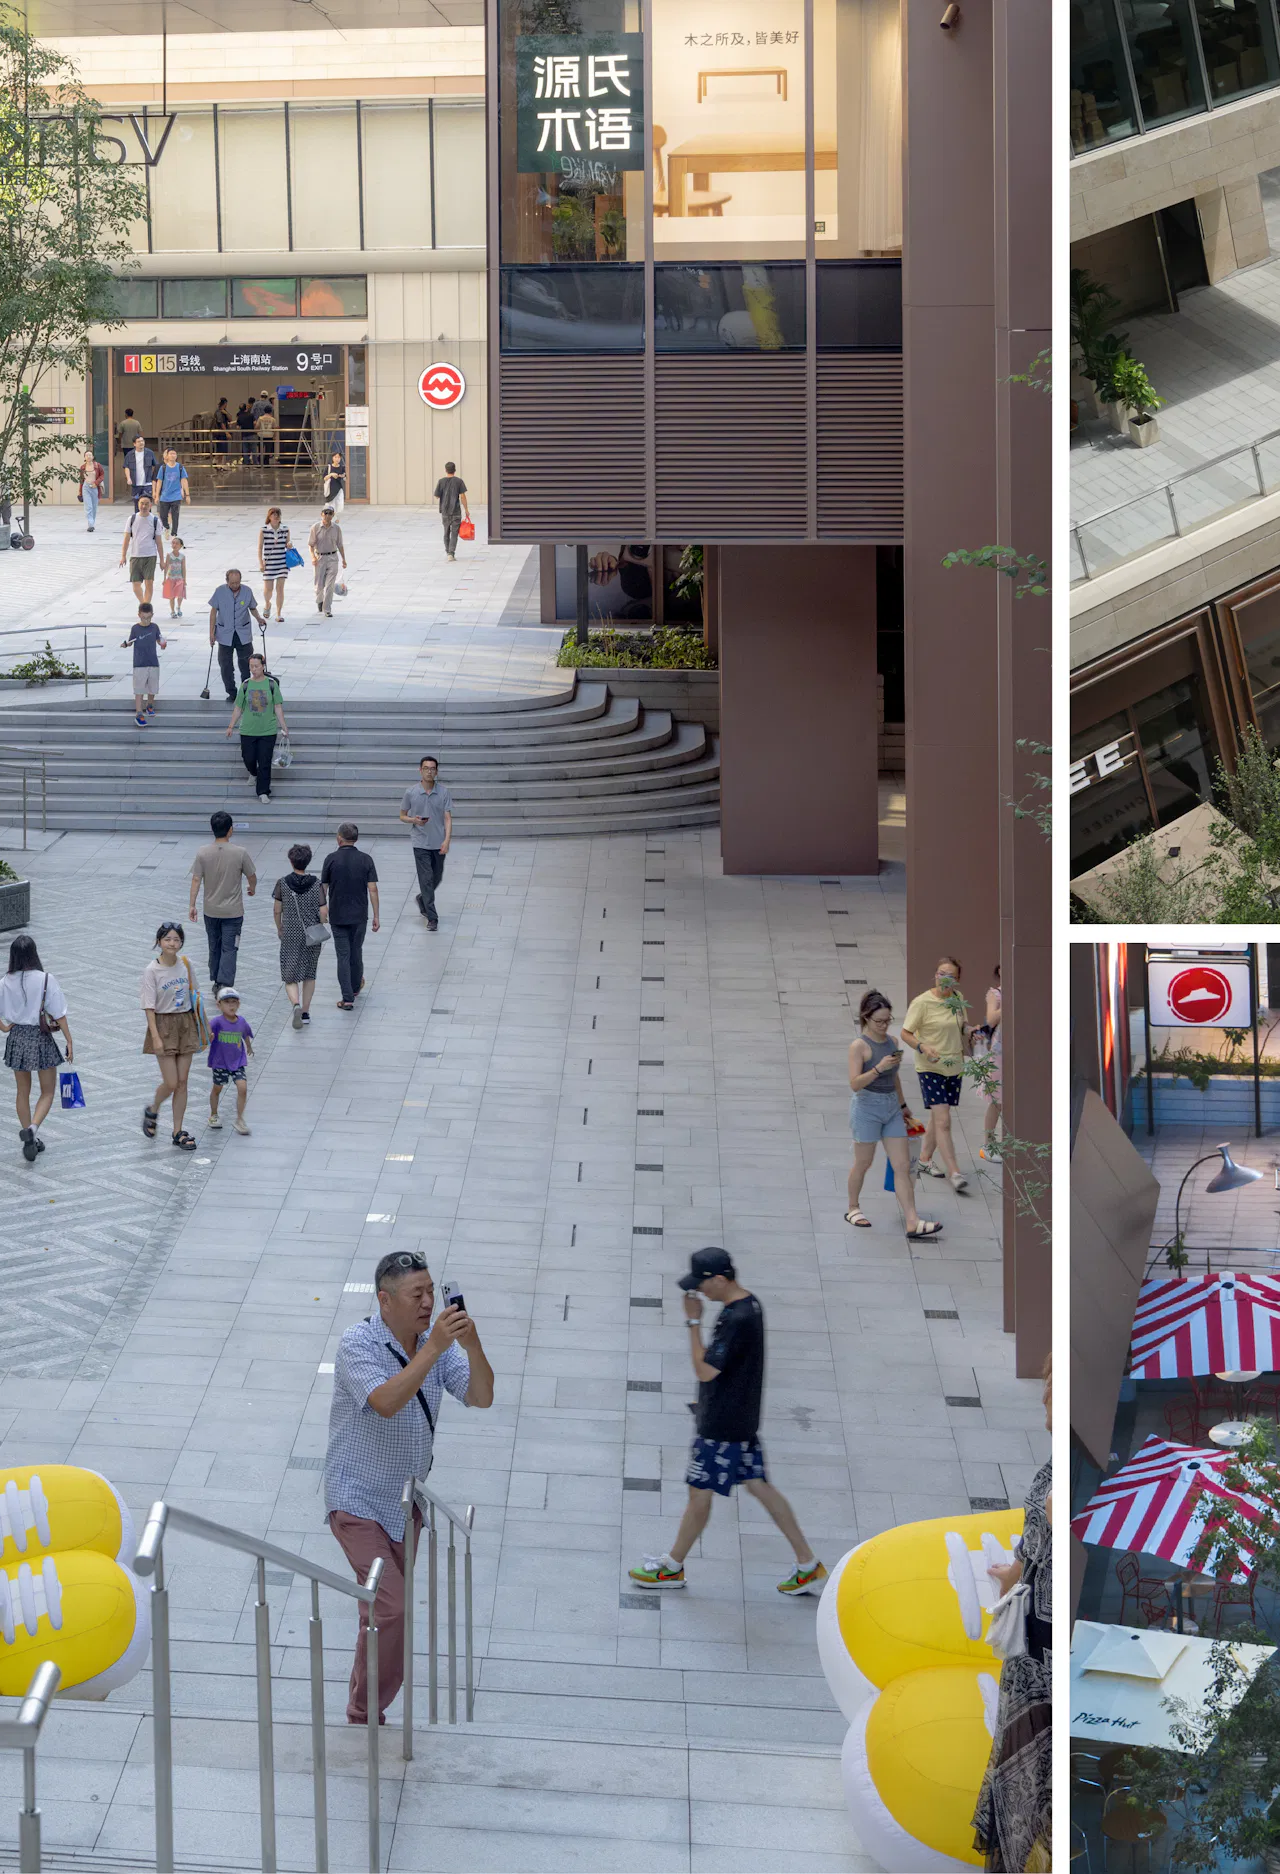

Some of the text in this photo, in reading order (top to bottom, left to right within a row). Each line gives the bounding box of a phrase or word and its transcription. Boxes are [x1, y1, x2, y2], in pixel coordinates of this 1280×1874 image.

[533, 54, 631, 99] 源氏
[536, 107, 632, 152] 木语
[128, 355, 201, 372] 1 3 15 号线
[230, 354, 272, 365] 上海南站
[296, 352, 333, 372] 9 号口
[1072, 1712, 1141, 1729] Pizza Hut
